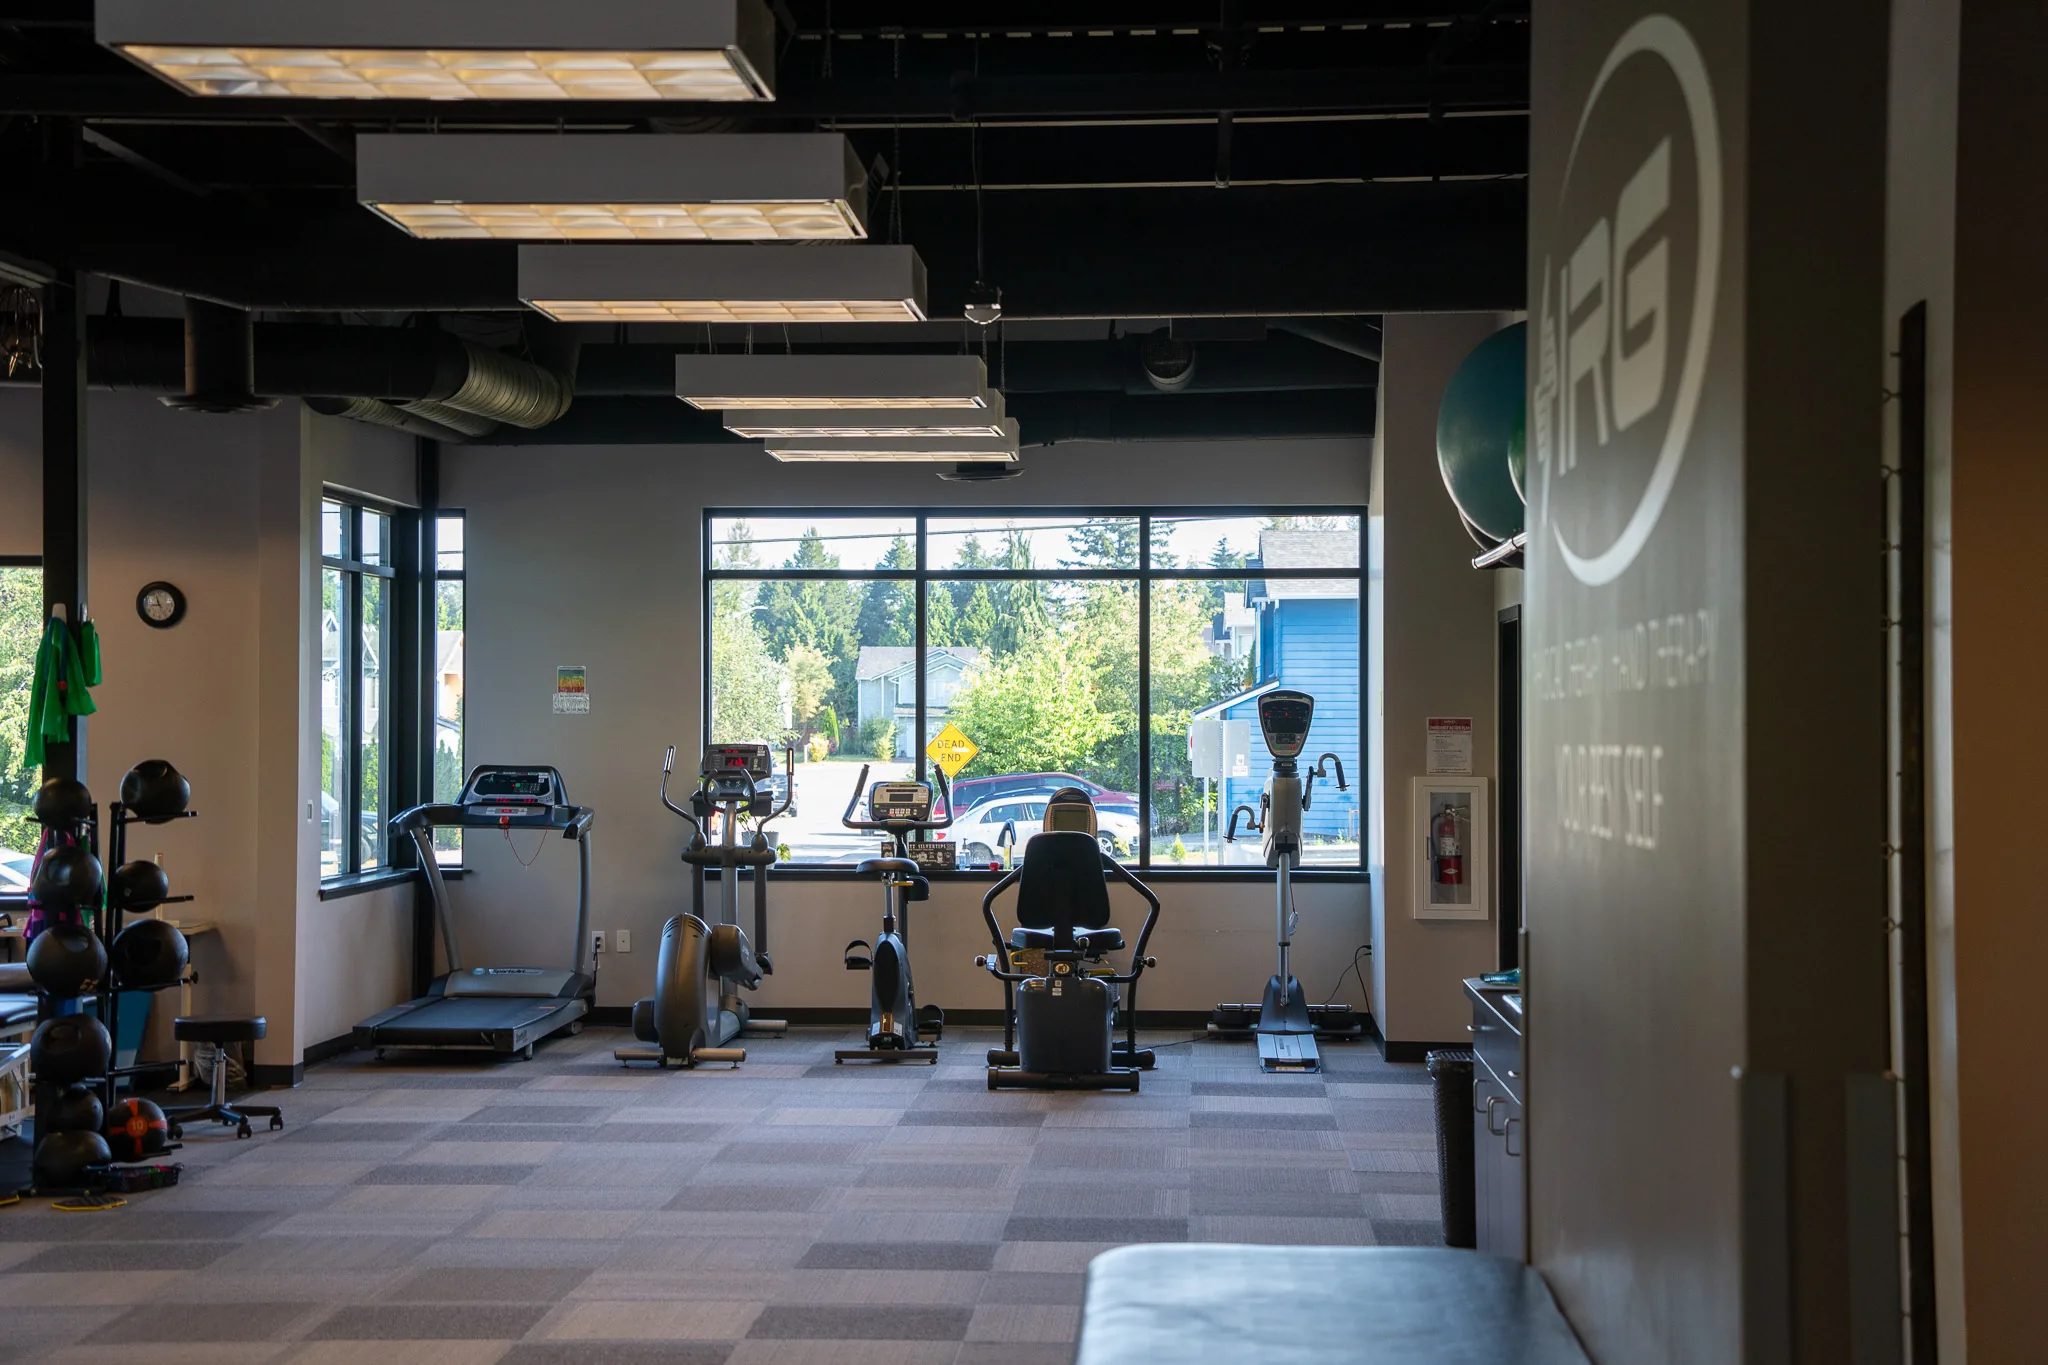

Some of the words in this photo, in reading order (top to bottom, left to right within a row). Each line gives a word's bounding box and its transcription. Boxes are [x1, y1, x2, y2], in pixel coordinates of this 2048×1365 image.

[937, 740, 965, 748] DEAD
[941, 754, 961, 762] END
[131, 1119, 144, 1130] 10
